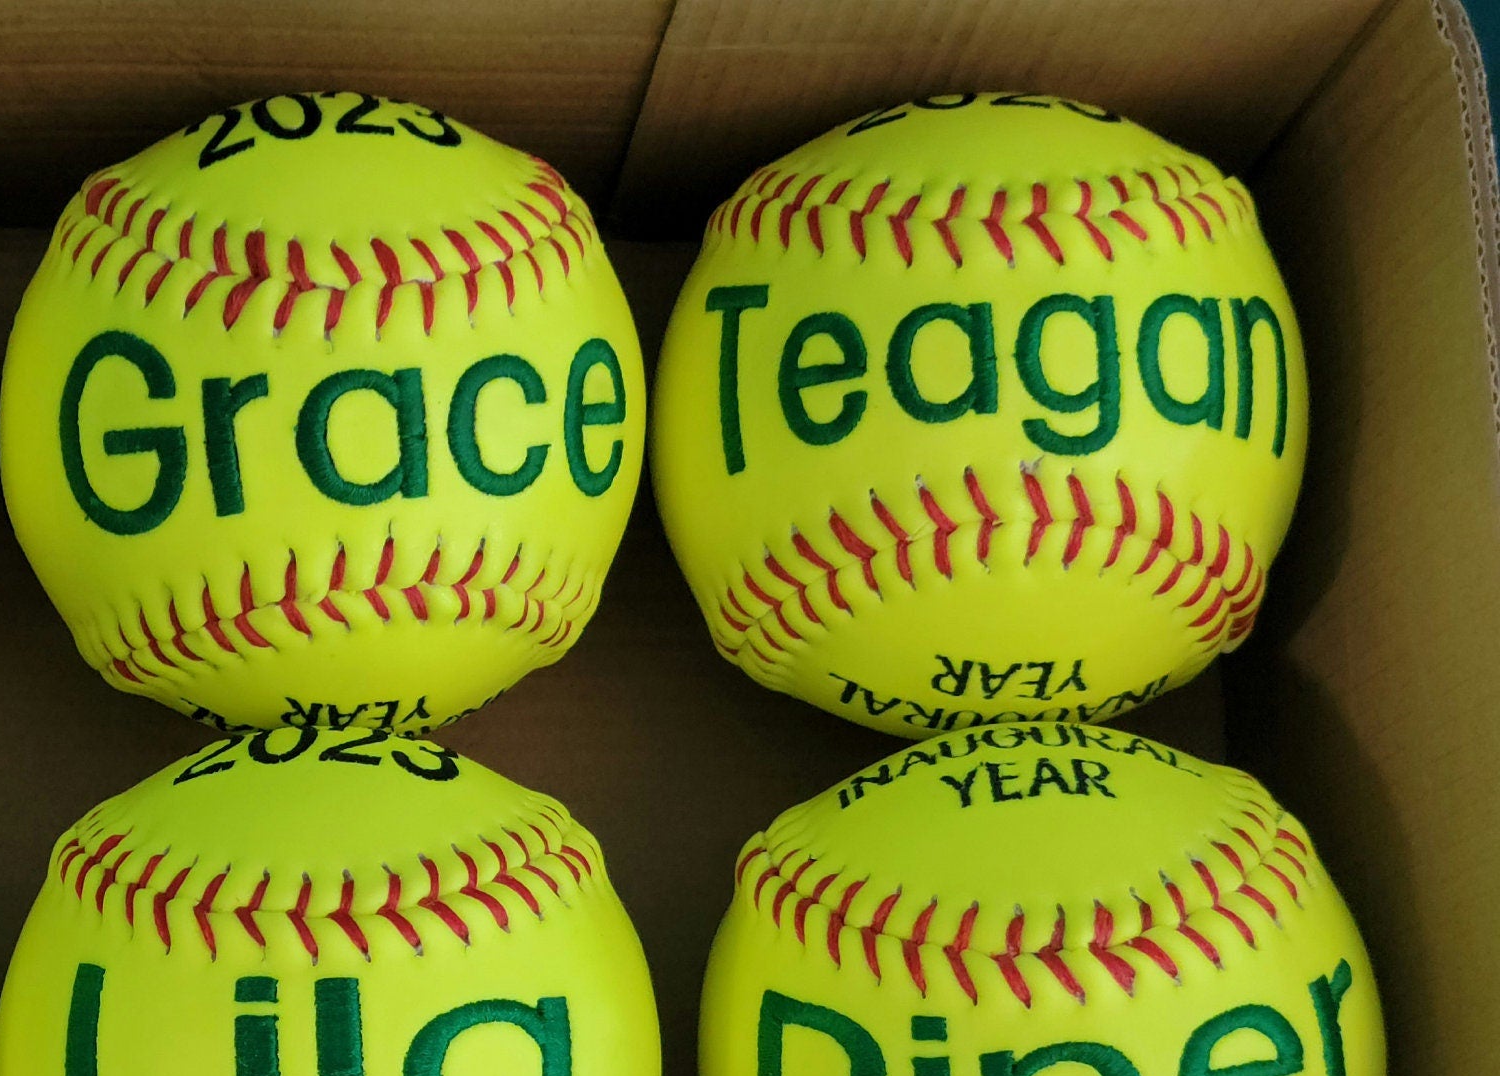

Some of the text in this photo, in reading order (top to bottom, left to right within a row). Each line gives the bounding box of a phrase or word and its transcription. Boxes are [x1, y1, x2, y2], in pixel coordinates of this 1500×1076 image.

[184, 92, 462, 170] 2023
[705, 284, 1288, 476] Teagan
[58, 329, 627, 536] Grace
[931, 655, 1088, 700] YEAR
[280, 696, 431, 730] YEAR
[173, 725, 459, 786] 2023
[836, 723, 1203, 810] INAUGURAL
[940, 758, 1116, 809] YEAR
